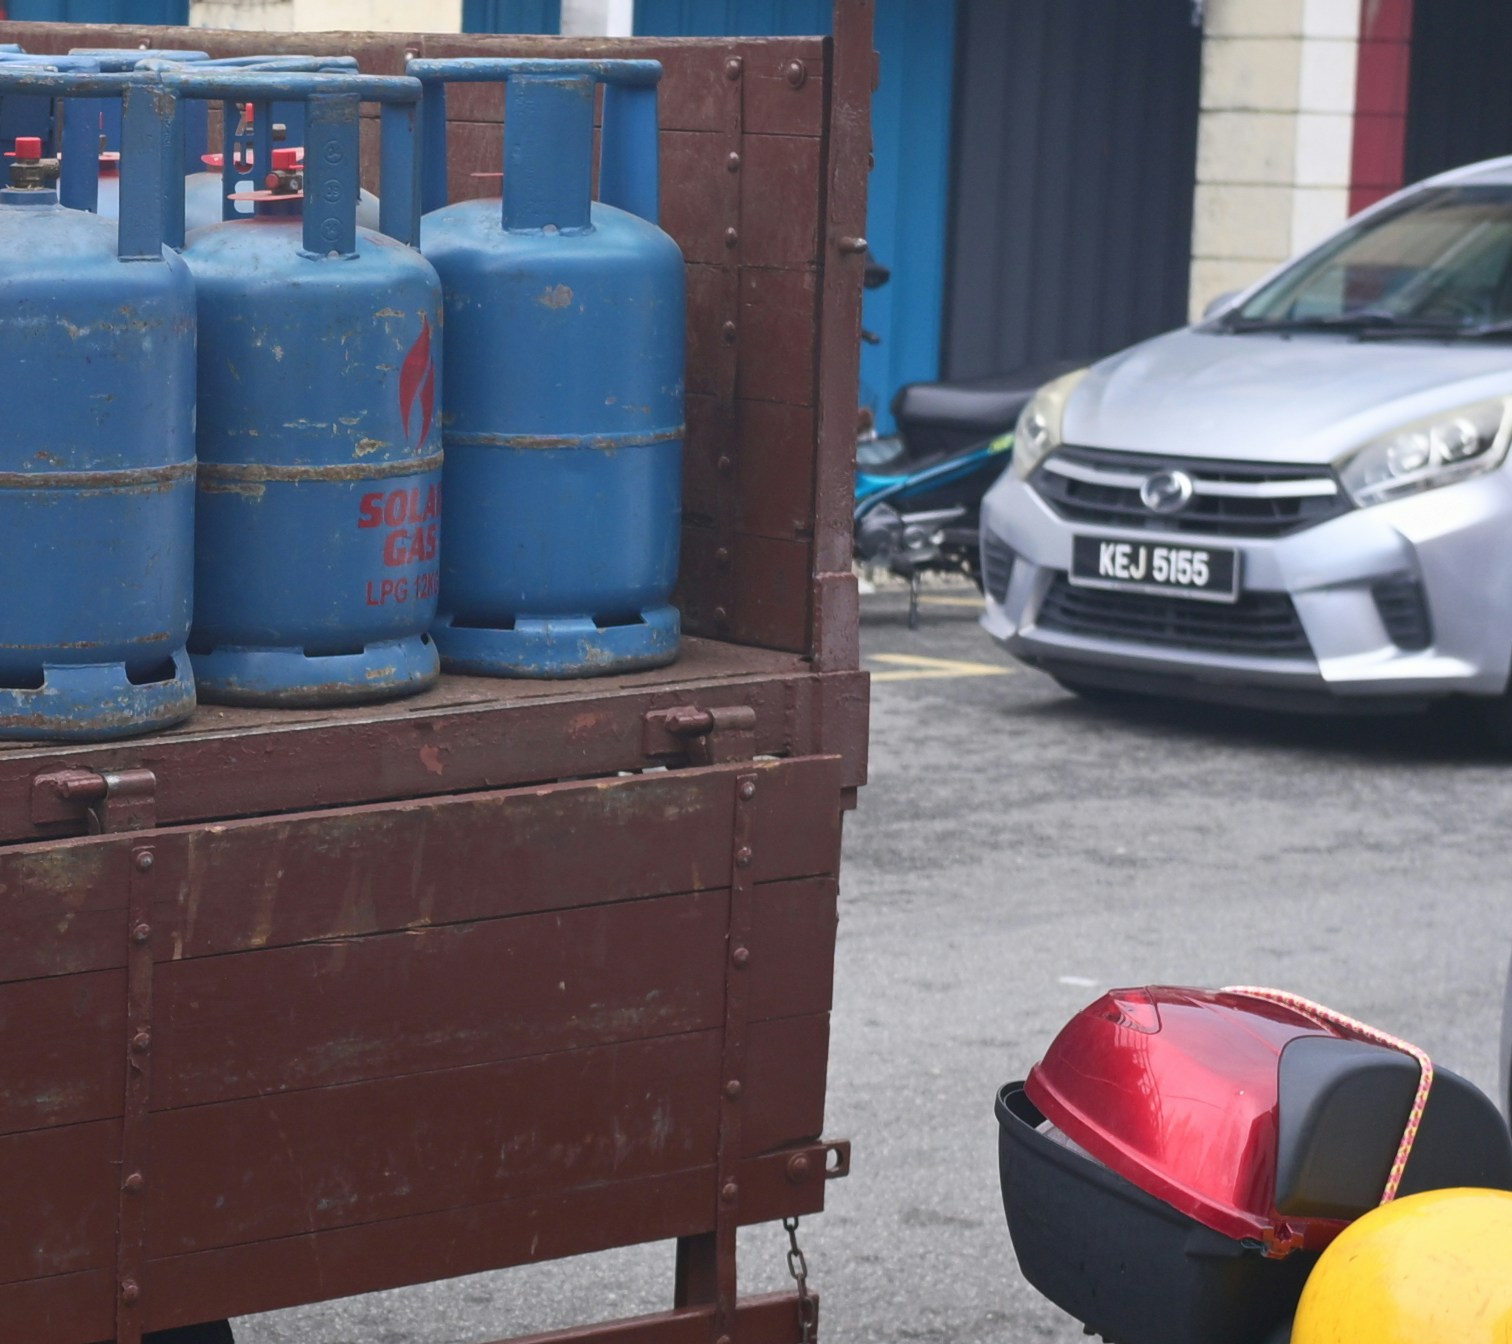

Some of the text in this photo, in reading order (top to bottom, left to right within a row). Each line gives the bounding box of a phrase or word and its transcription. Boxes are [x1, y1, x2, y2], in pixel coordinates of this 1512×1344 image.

[383, 522, 439, 568] GAS
[1098, 541, 1210, 587] KEJ 5155
[366, 576, 408, 607] LPG
